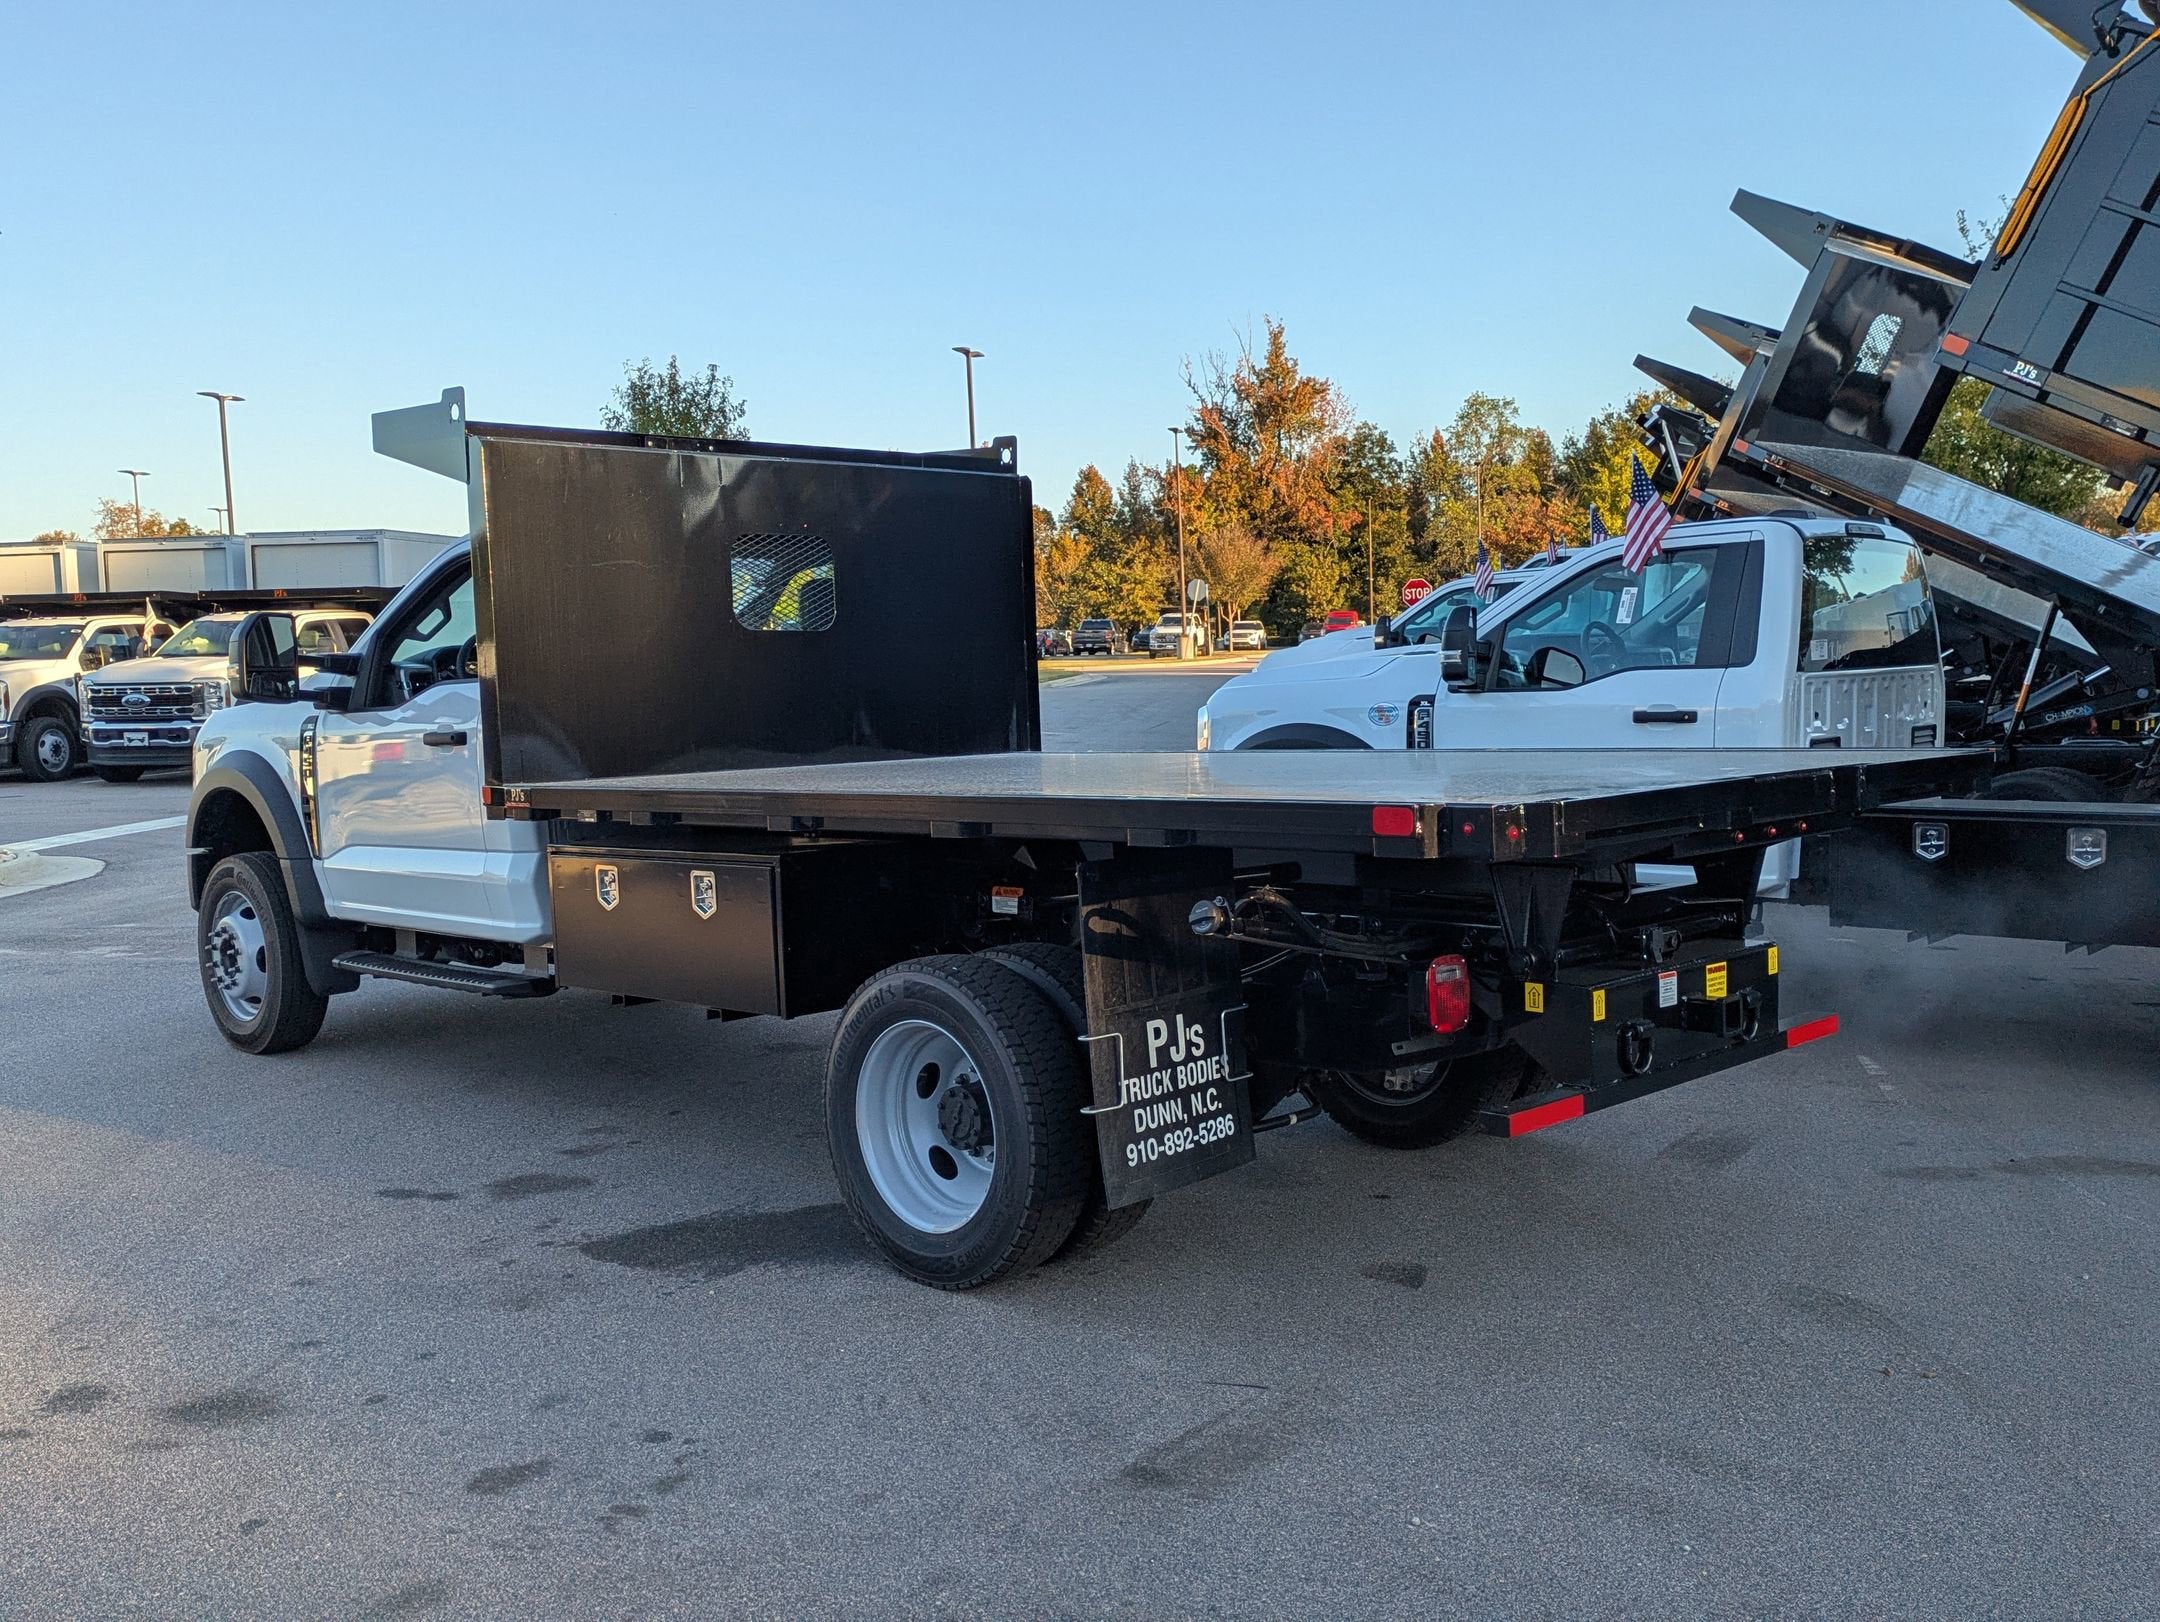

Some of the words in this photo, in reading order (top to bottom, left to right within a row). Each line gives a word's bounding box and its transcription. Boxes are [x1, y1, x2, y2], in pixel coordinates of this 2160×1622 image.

[2012, 360, 2038, 380] PJ's
[1404, 587, 1430, 600] STOP
[510, 788, 525, 802] PJ's
[1146, 1013, 1205, 1069] PJ's
[1123, 1068, 1174, 1105] TRUCK
[1176, 1054, 1230, 1090] BODIES
[1134, 1097, 1188, 1134] DUNN,
[1191, 1087, 1223, 1117] N.C.
[1126, 1113, 1235, 1168] 910-892-5286
